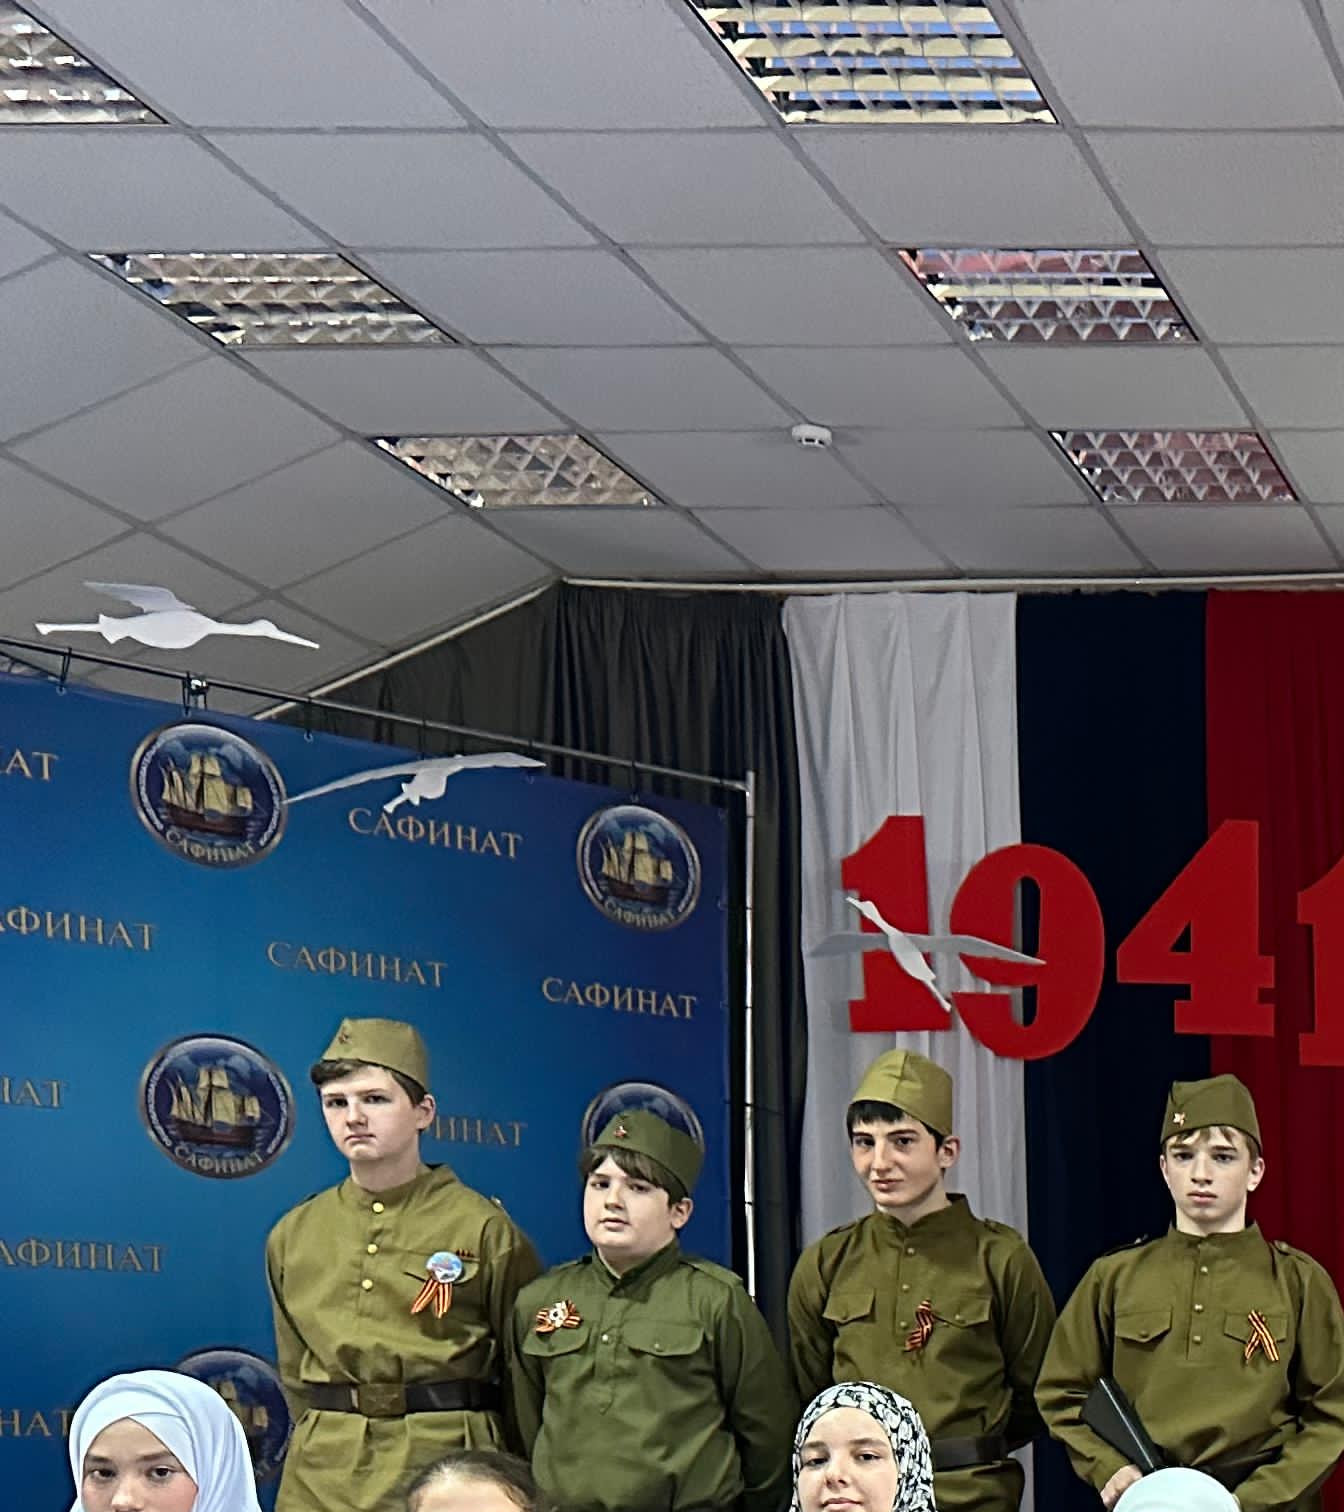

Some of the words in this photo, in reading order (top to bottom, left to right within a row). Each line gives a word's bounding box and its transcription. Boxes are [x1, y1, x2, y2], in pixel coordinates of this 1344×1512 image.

[348, 807, 524, 860] САФИНАТ
[0, 905, 157, 951] ФИНАТ
[267, 941, 448, 988] САФИНАТ
[542, 977, 698, 1020] САФИНАТ
[430, 1115, 528, 1147] ИНАТ
